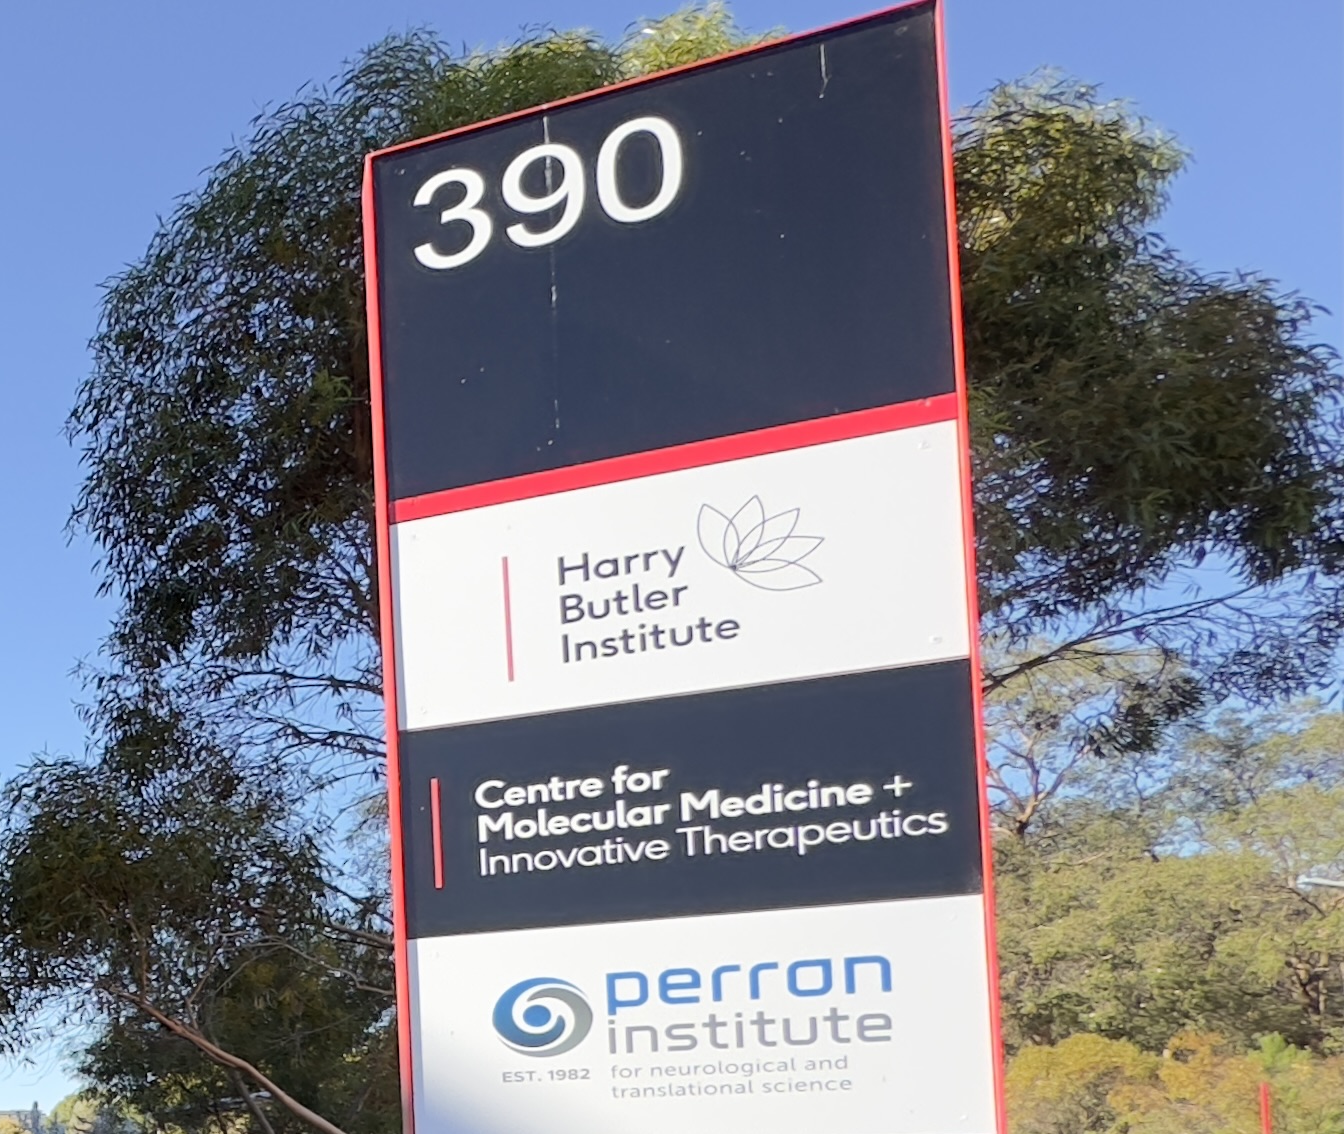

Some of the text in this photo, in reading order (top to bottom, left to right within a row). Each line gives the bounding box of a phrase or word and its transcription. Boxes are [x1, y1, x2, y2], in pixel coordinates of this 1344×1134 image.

[413, 116, 684, 270] 390
[557, 545, 686, 586] Harry
[560, 584, 688, 625] Butler
[561, 617, 741, 664] Institute
[474, 765, 671, 810] Centre for
[478, 802, 669, 843] Molecular
[680, 780, 873, 822] Medicine
[479, 808, 948, 877] Innovative Therapeutics
[605, 954, 893, 1016] perron
[608, 1006, 893, 1055] institute
[501, 1068, 591, 1083] EST. 1982
[611, 1054, 849, 1083] for neurological and
[611, 1076, 853, 1099] translational science
